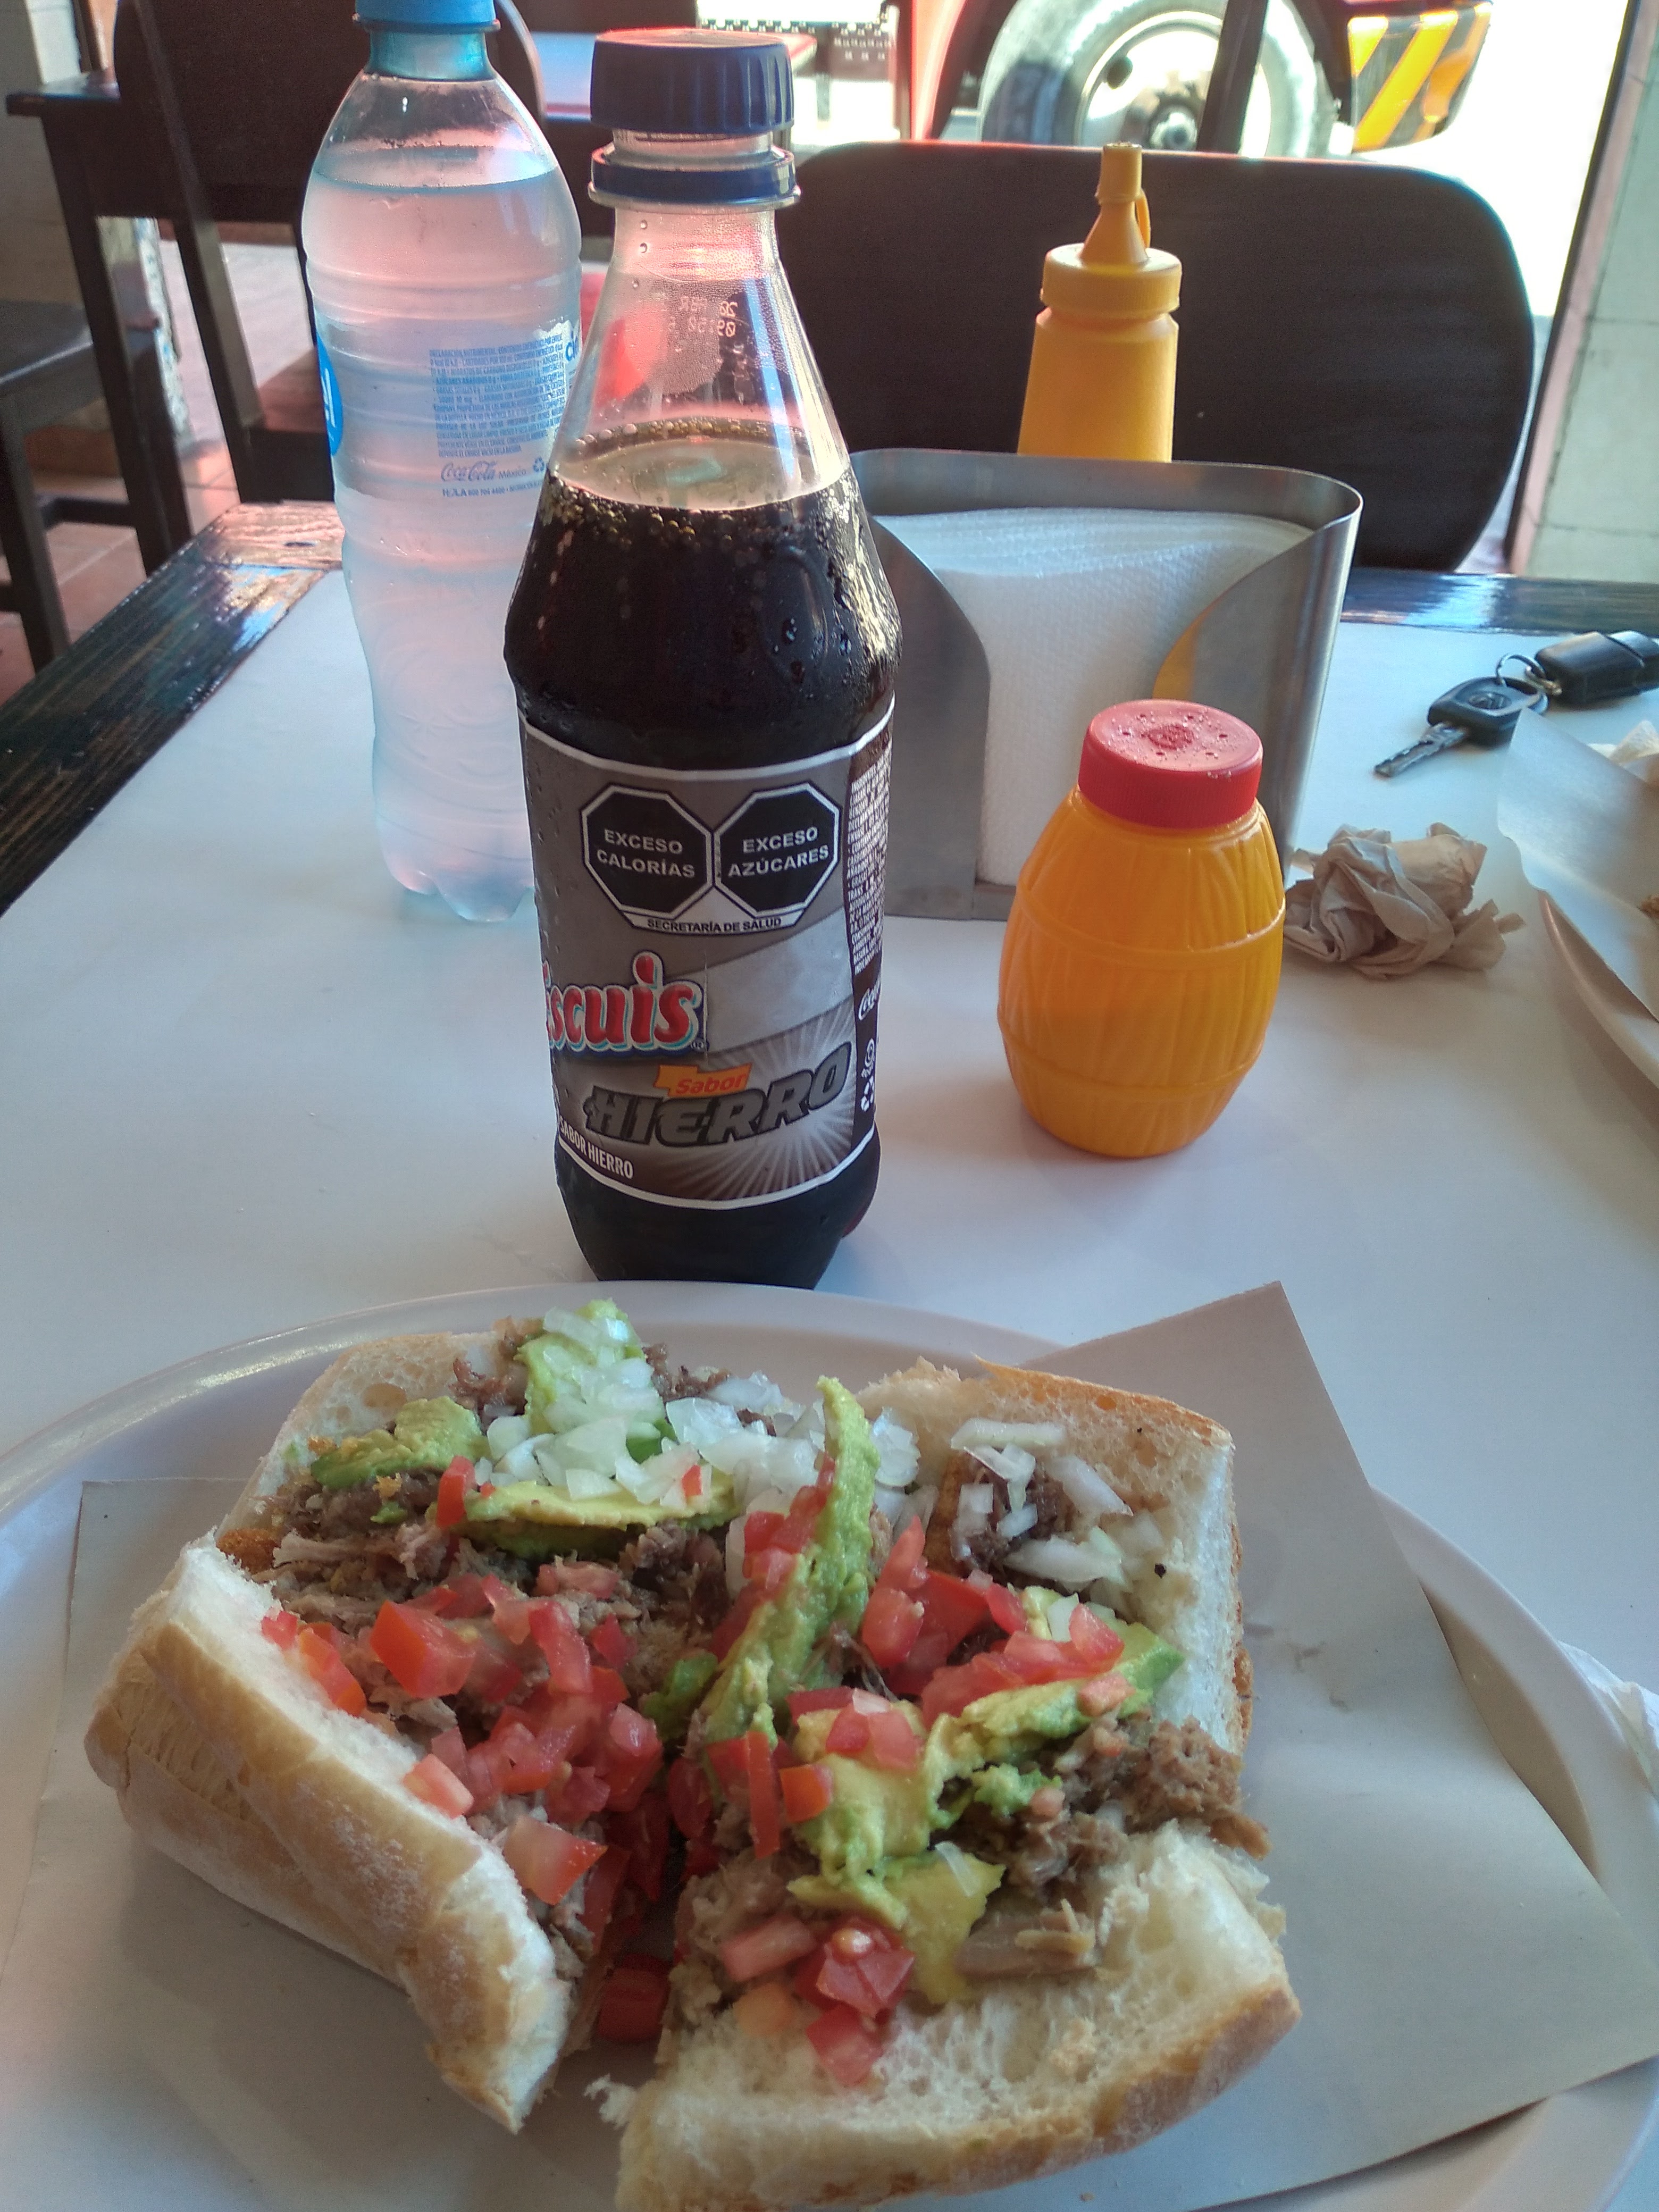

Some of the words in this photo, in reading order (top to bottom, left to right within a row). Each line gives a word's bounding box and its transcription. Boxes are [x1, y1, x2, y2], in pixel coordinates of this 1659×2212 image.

[604, 828, 684, 854] EXCESO
[742, 826, 819, 853] EXCESO
[596, 849, 695, 878] CALORÍAS
[728, 845, 830, 878] AZÚCARES
[647, 917, 722, 932] SECRETARÍA
[724, 920, 741, 933] DE
[742, 916, 782, 931] SALUD
[583, 1042, 852, 1148] HIERRO
[676, 1073, 747, 1094] Sabor
[559, 1115, 588, 1157] SABOR
[588, 1141, 634, 1179] HIERRO
